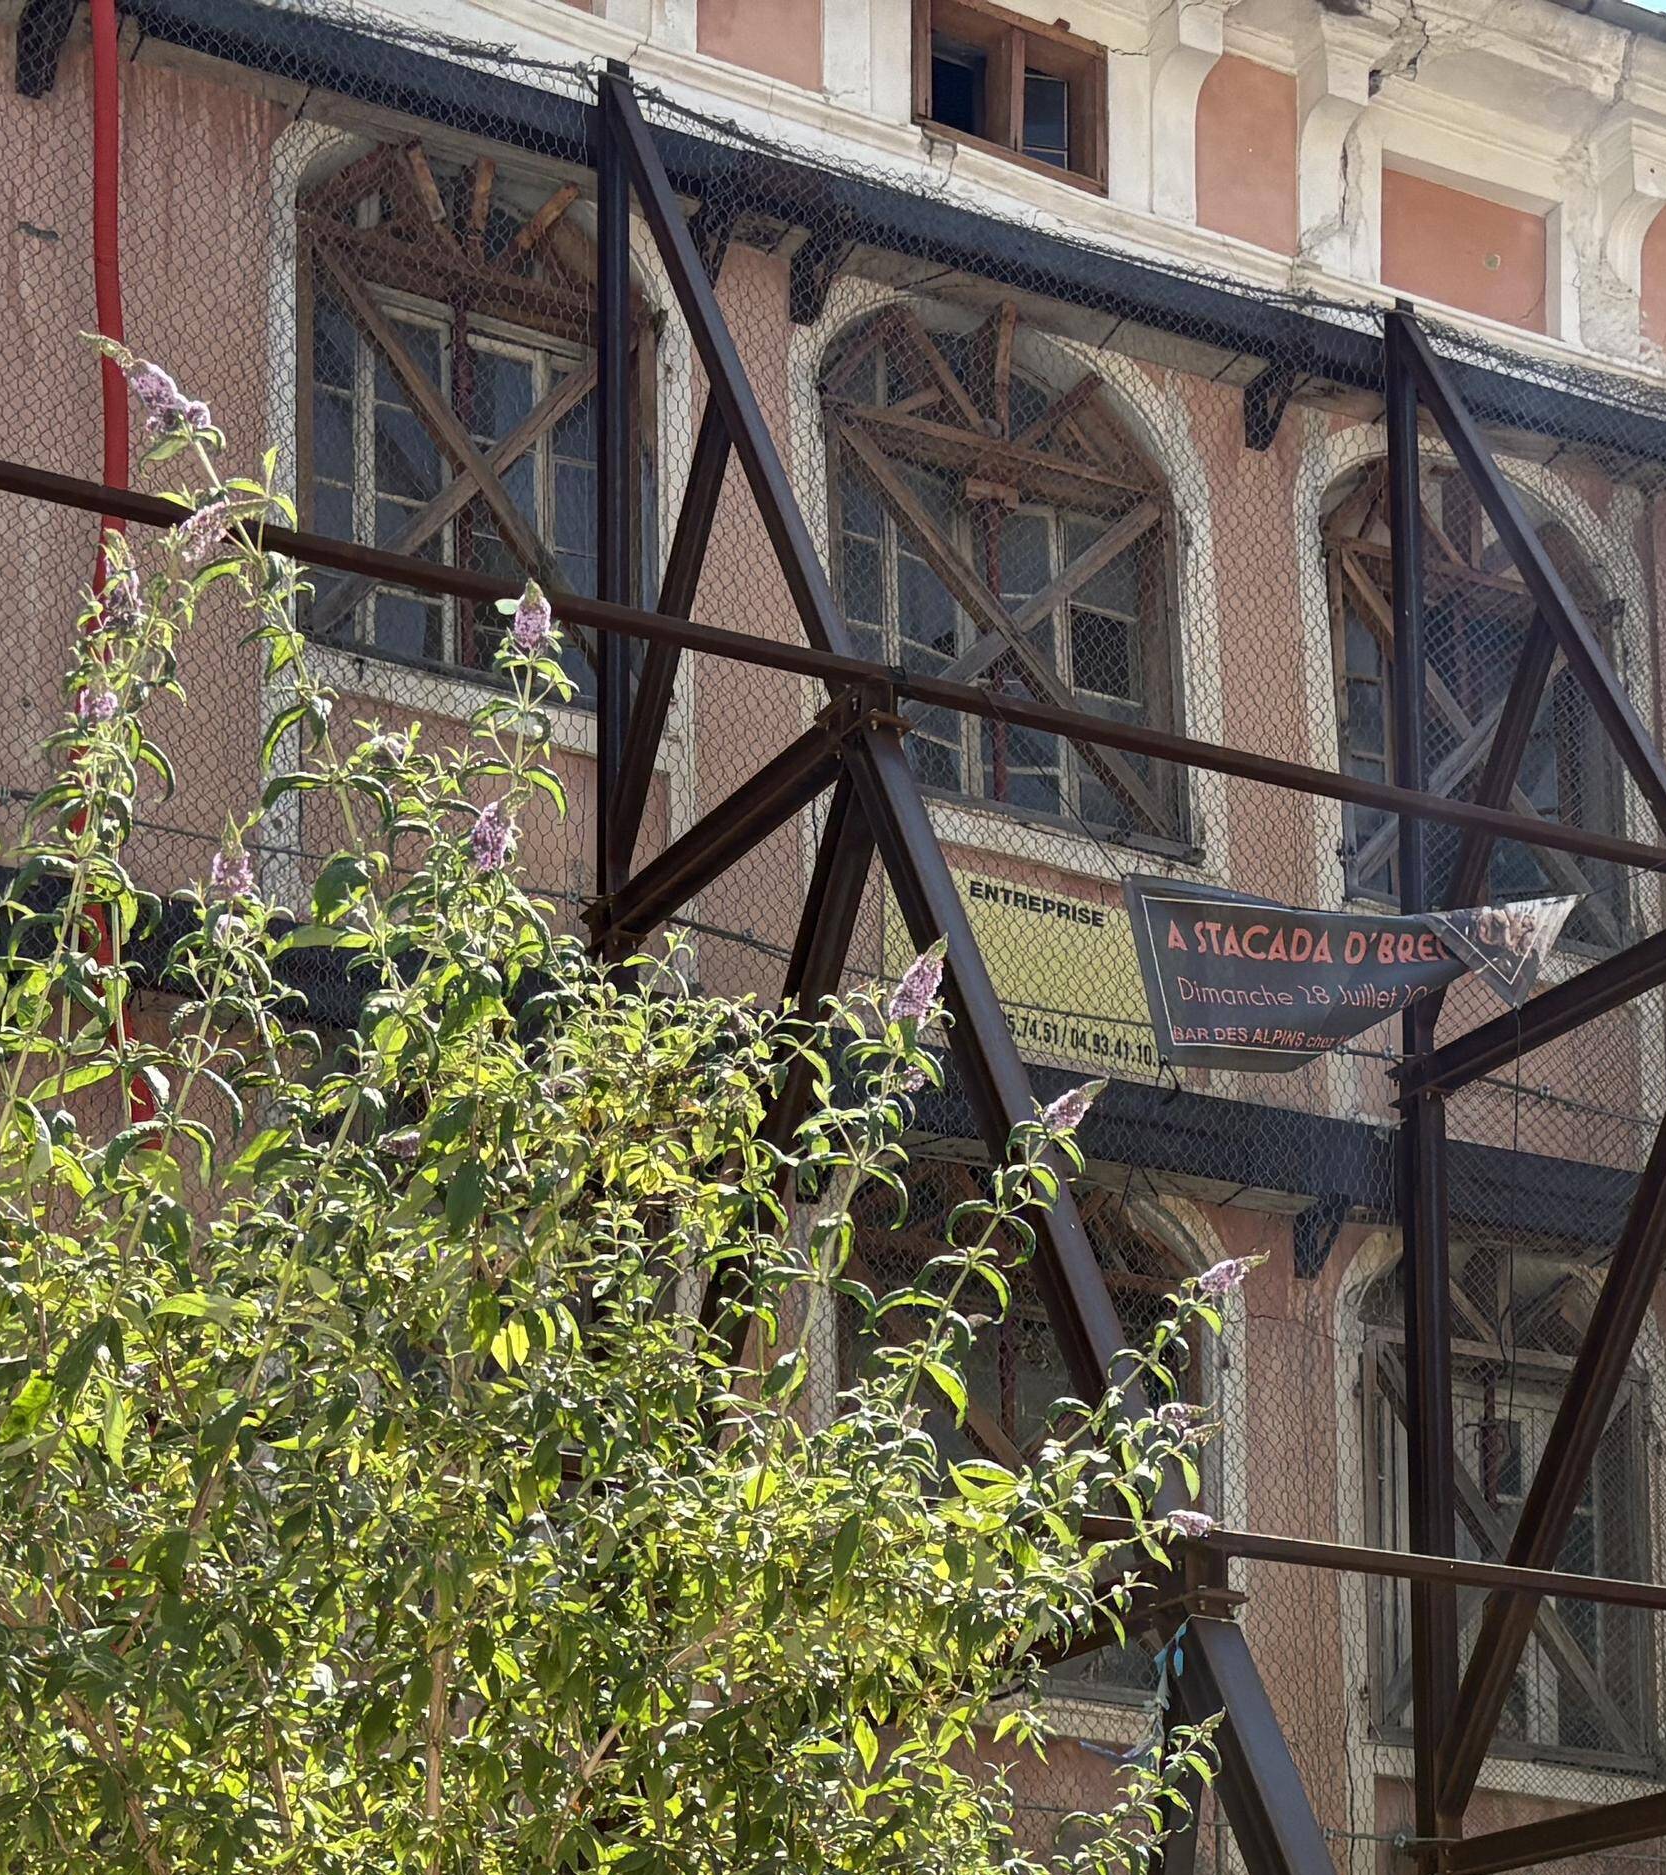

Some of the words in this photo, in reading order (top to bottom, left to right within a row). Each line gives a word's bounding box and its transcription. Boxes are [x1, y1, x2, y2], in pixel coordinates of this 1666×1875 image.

[968, 879, 1106, 930] ENTREPRISE
[1166, 919, 1189, 952] A
[1193, 920, 1334, 964] STACADA
[1177, 975, 1294, 1006] Dimanche
[1338, 983, 1397, 1009] Juillet
[1173, 1025, 1210, 1043] BAR
[1213, 1026, 1248, 1043] DES
[1250, 1027, 1305, 1048] ALPINS
